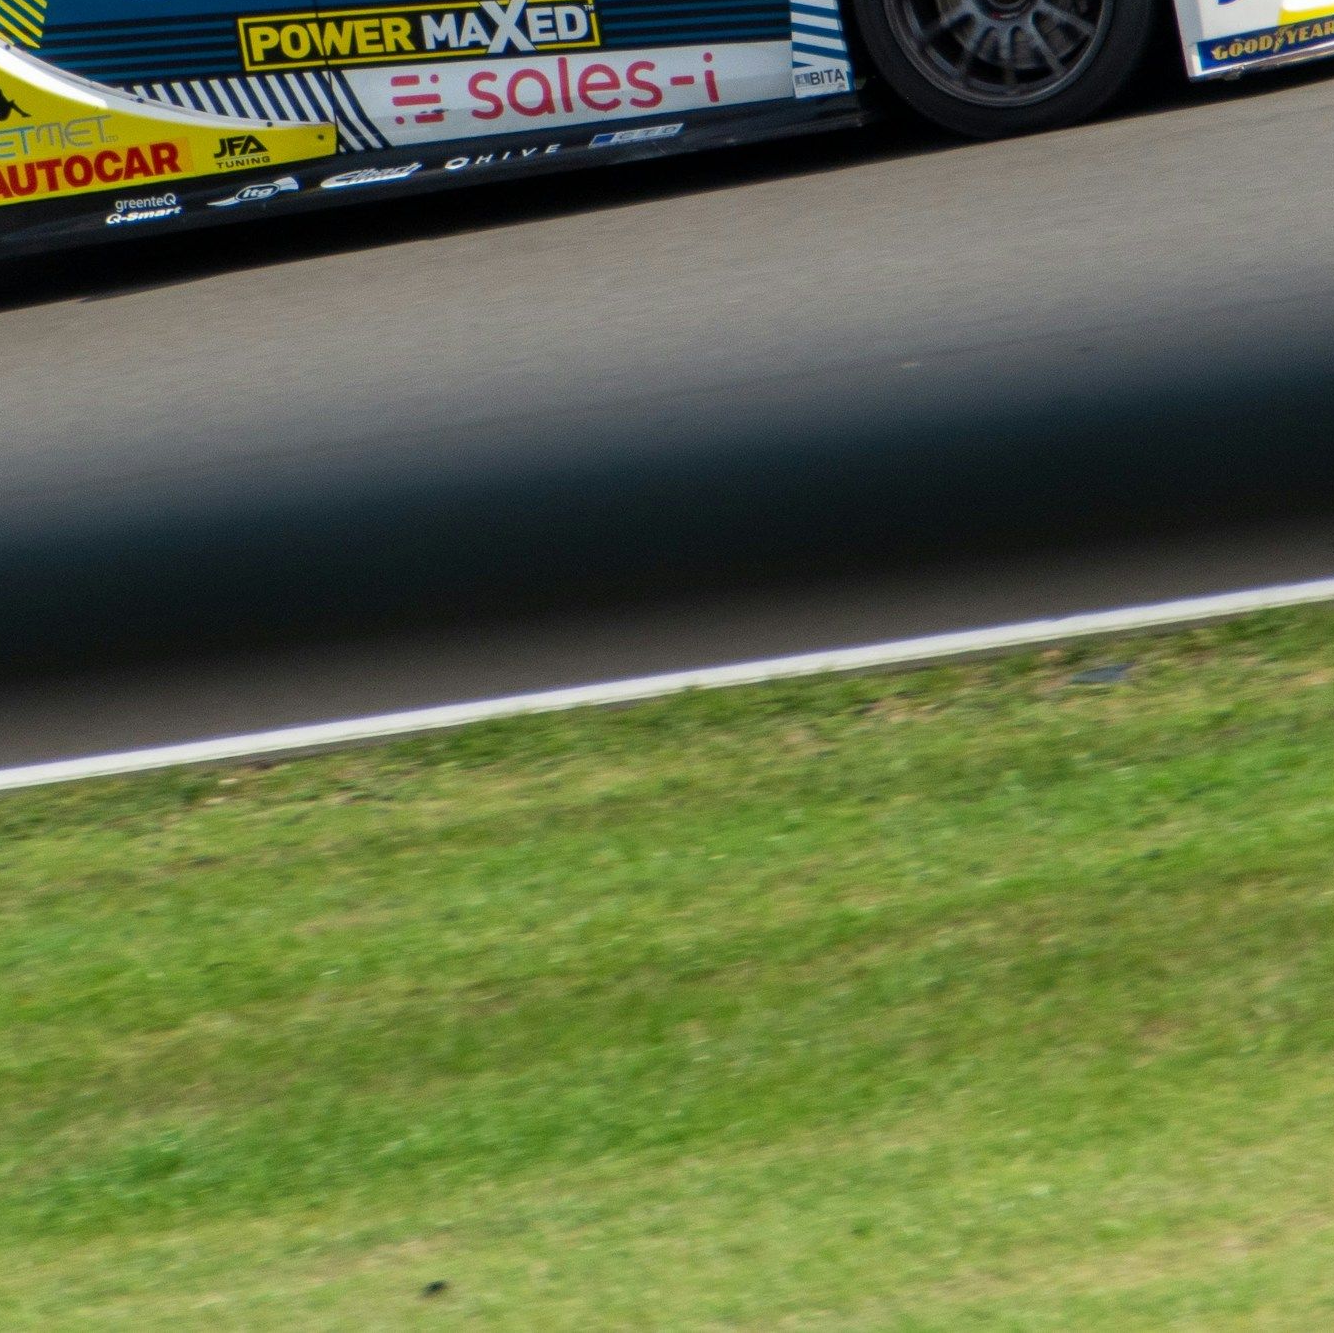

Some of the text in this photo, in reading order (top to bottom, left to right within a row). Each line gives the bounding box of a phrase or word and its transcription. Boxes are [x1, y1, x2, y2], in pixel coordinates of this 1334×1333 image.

[249, 17, 416, 62] POWER
[468, 52, 721, 120] sales-i
[810, 68, 845, 86] BITA
[214, 134, 269, 159] JFA
[216, 156, 271, 169] TUNING
[115, 193, 177, 213] greenteQ
[106, 206, 182, 225] Q-Smart
